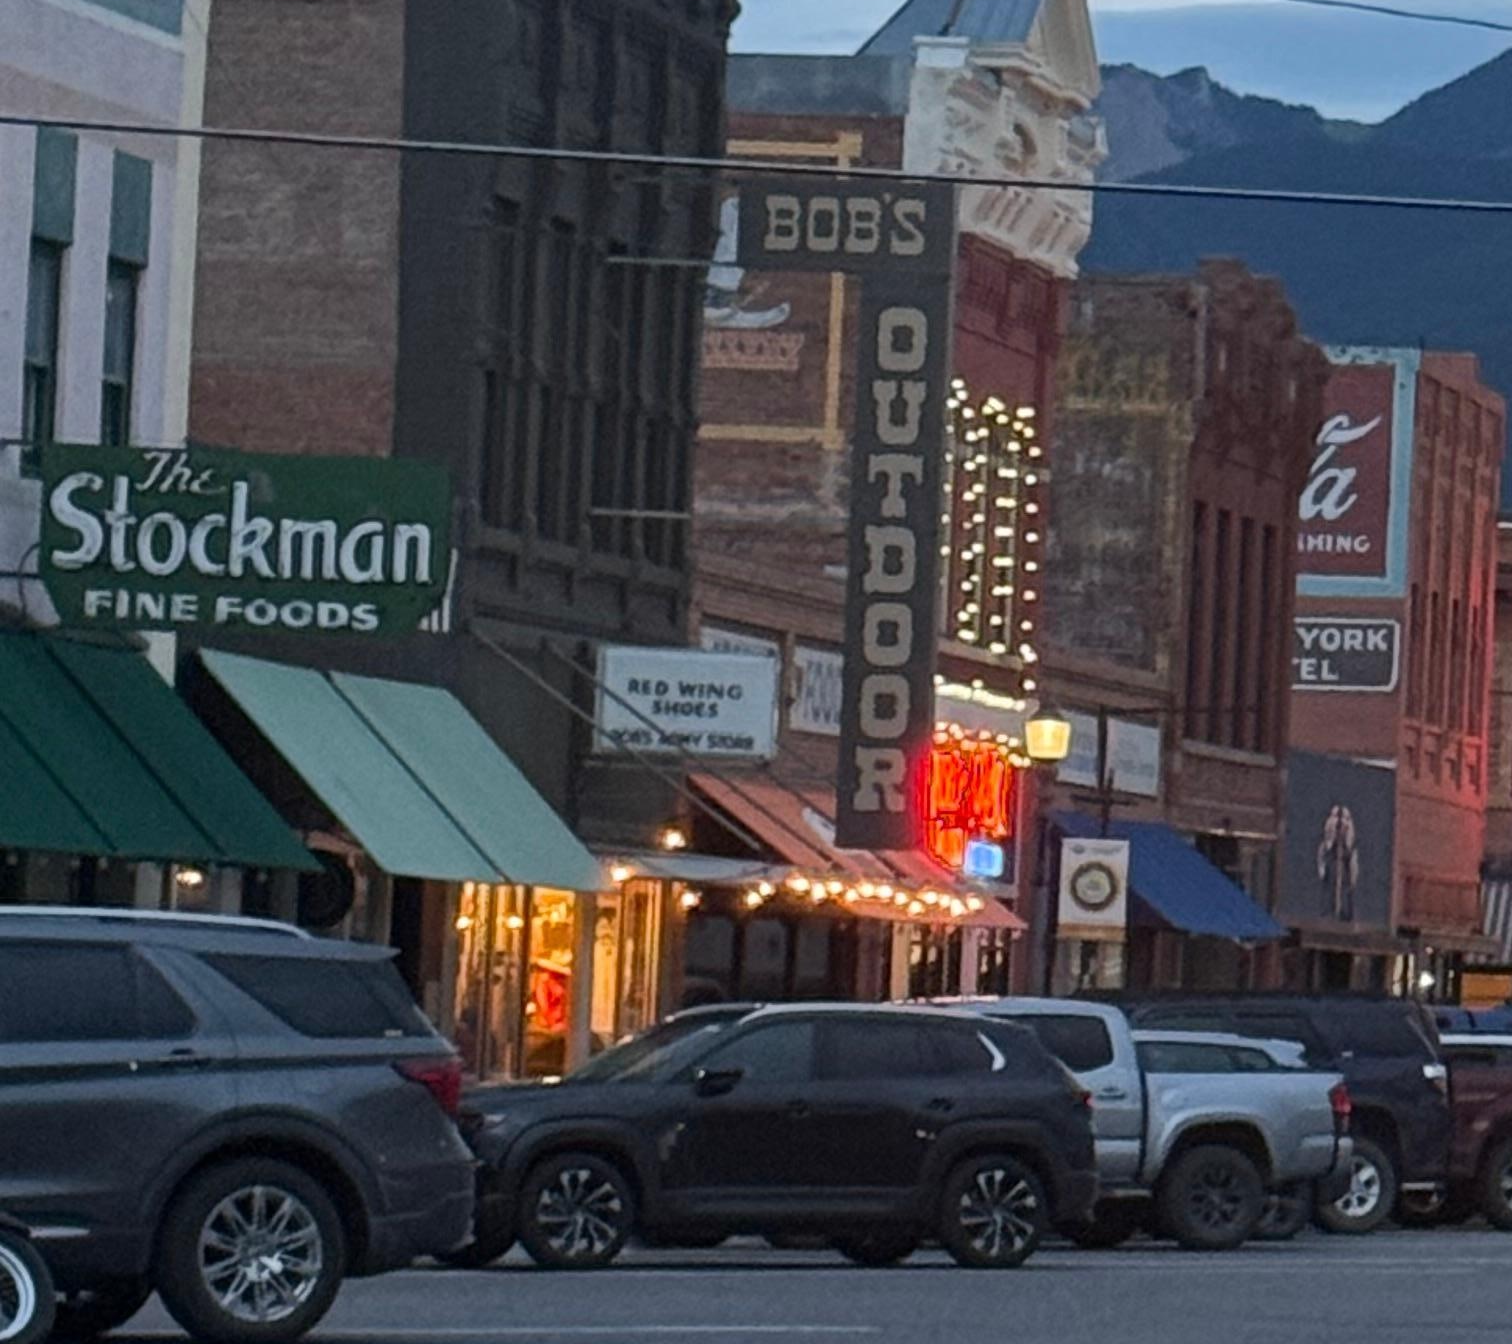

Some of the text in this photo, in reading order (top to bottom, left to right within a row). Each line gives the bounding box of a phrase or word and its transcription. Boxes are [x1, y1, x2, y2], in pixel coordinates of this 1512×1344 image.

[764, 193, 926, 255] BOB'S
[135, 452, 226, 494] The
[50, 471, 433, 584] Stockman
[853, 307, 929, 813] OUTDOOR
[84, 589, 380, 631] FINE FOODS
[1296, 627, 1389, 652] YORK
[627, 678, 743, 700] RED WING
[652, 700, 719, 718] SHOES
